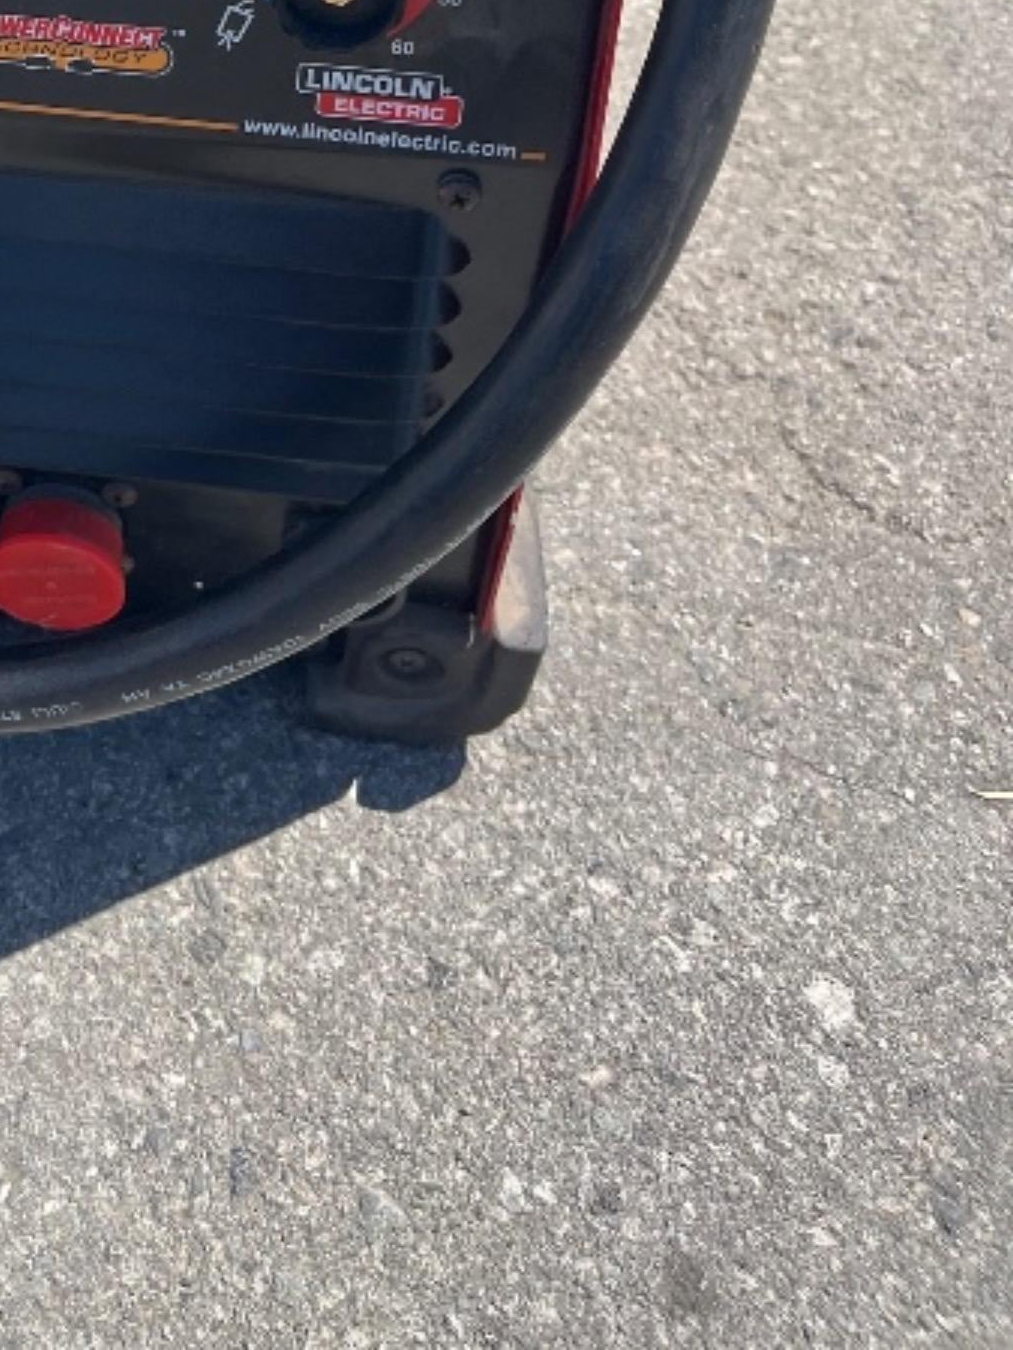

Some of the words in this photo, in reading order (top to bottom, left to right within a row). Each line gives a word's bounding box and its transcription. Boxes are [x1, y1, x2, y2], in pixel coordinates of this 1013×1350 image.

[305, 68, 436, 100] LINCOLN
[333, 97, 446, 122] ELECTRIC
[243, 117, 517, 160] www.lincolnelectric.com
